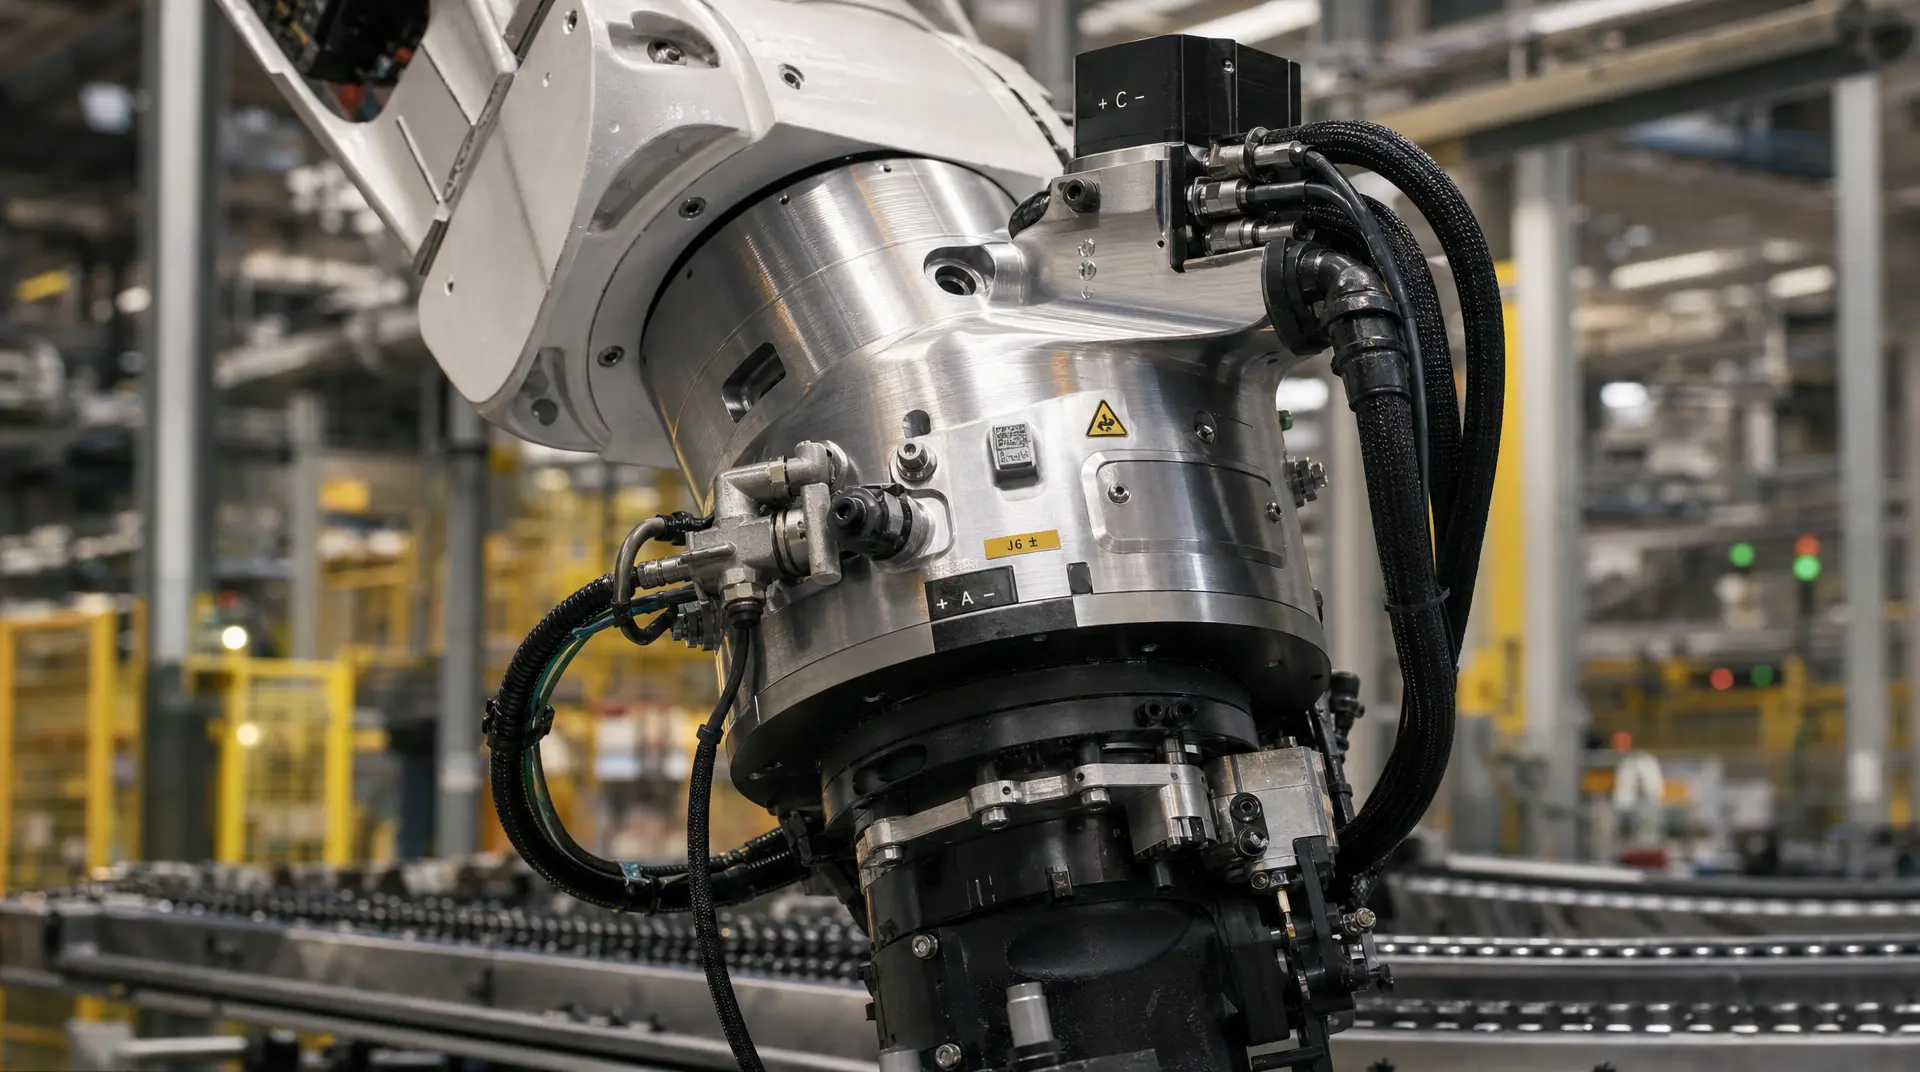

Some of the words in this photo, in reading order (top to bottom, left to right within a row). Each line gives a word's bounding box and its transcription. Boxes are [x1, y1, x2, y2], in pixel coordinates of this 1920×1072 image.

[1115, 91, 1127, 108] C
[1007, 539, 1023, 551] J6
[961, 591, 974, 606] A
